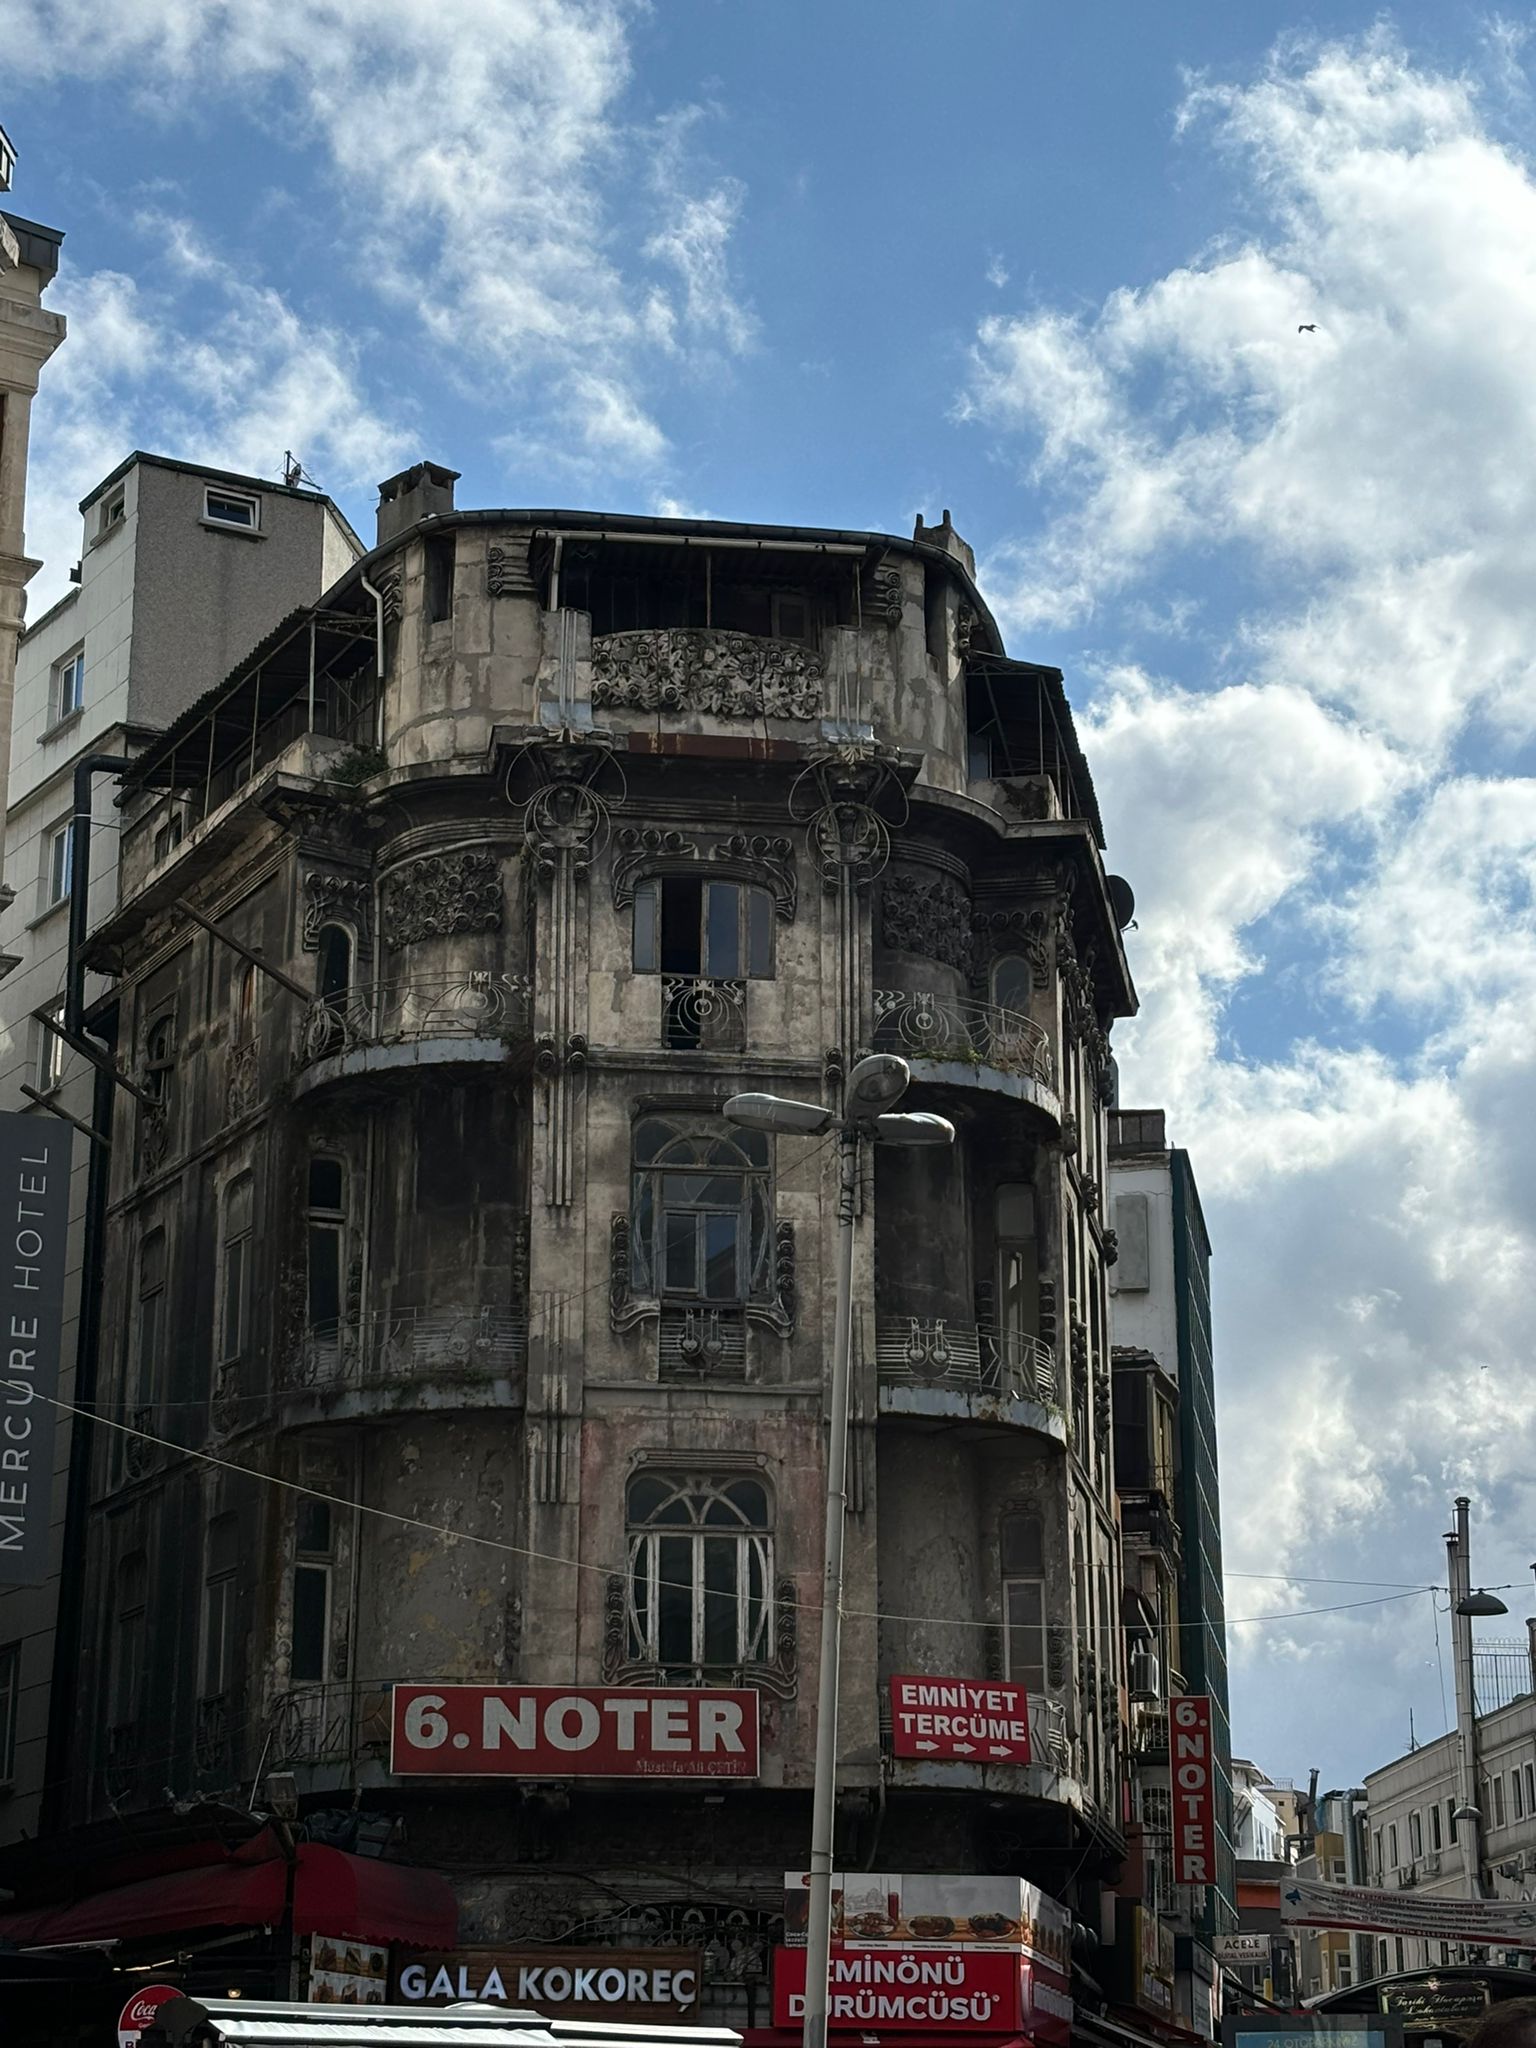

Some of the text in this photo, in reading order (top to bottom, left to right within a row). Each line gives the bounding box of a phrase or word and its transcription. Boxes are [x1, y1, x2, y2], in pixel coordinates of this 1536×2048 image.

[0, 1147, 48, 1550] MERCURE HOTEL
[901, 1683, 1018, 1712] EMNİYET
[404, 1695, 746, 1752] 6. NOTER
[899, 1712, 1026, 1741] TERCÜME
[1175, 1702, 1208, 1880] 6. NOTER
[1224, 1939, 1260, 1950] ACELE
[400, 1965, 696, 2013] GALA KOKOREÇ
[788, 1989, 992, 2021] DRÜMCÜSÜ
